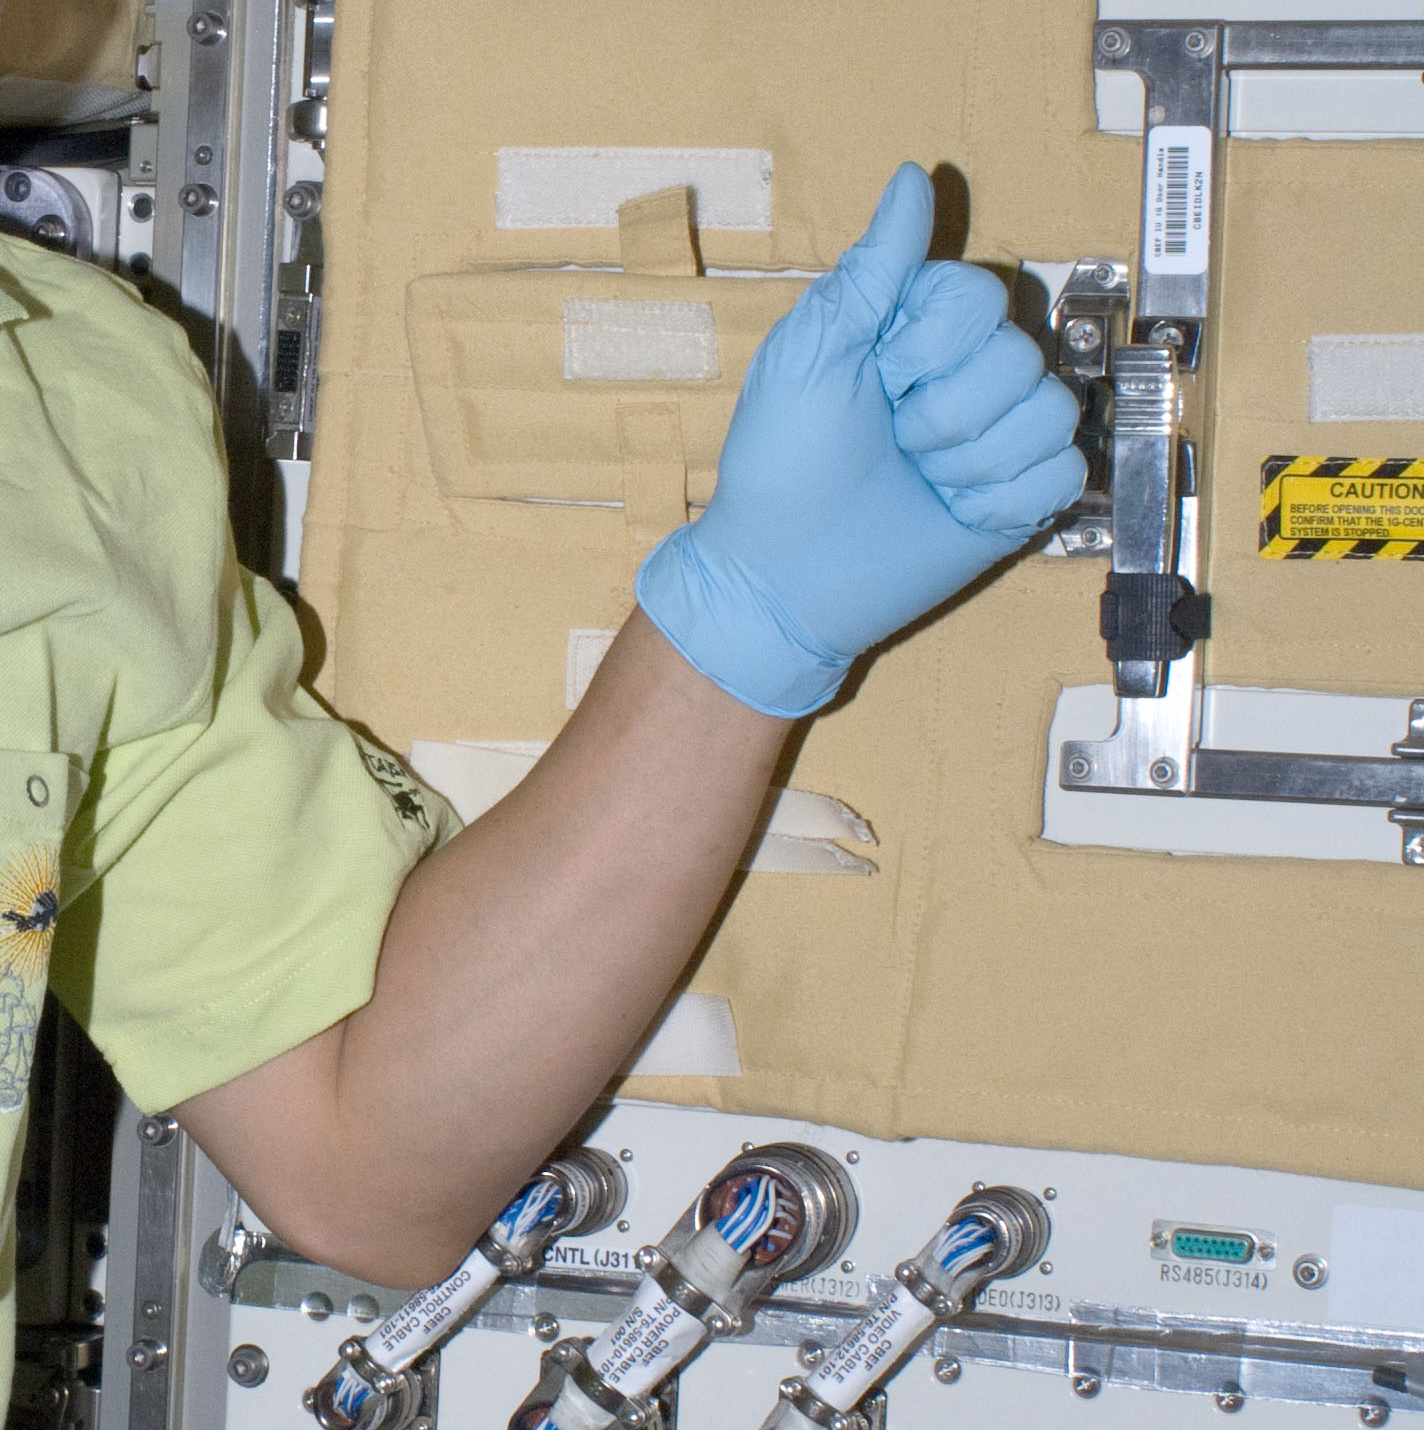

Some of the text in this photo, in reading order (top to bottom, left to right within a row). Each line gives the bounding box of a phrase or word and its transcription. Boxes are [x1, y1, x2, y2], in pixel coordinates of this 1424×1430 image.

[1330, 482, 1424, 500] CAUTION
[1290, 503, 1402, 515] BEFORE OPENING THIS
[1290, 515, 1384, 527] CONFIRM THAT THE
[1290, 527, 1330, 537] SYSTEM
[1332, 528, 1341, 537] IS
[543, 1245, 590, 1267] CNTL
[1160, 1263, 1268, 1291] RS485(J314)
[382, 1269, 473, 1352] CONTROL CABLE
[422, 1305, 452, 1335] CBEF
[626, 1307, 643, 1327] S/N
[610, 1307, 681, 1384] POWER CABLE
[832, 1308, 902, 1384] VIDEO CABLE
[863, 1339, 893, 1371] CBEF
